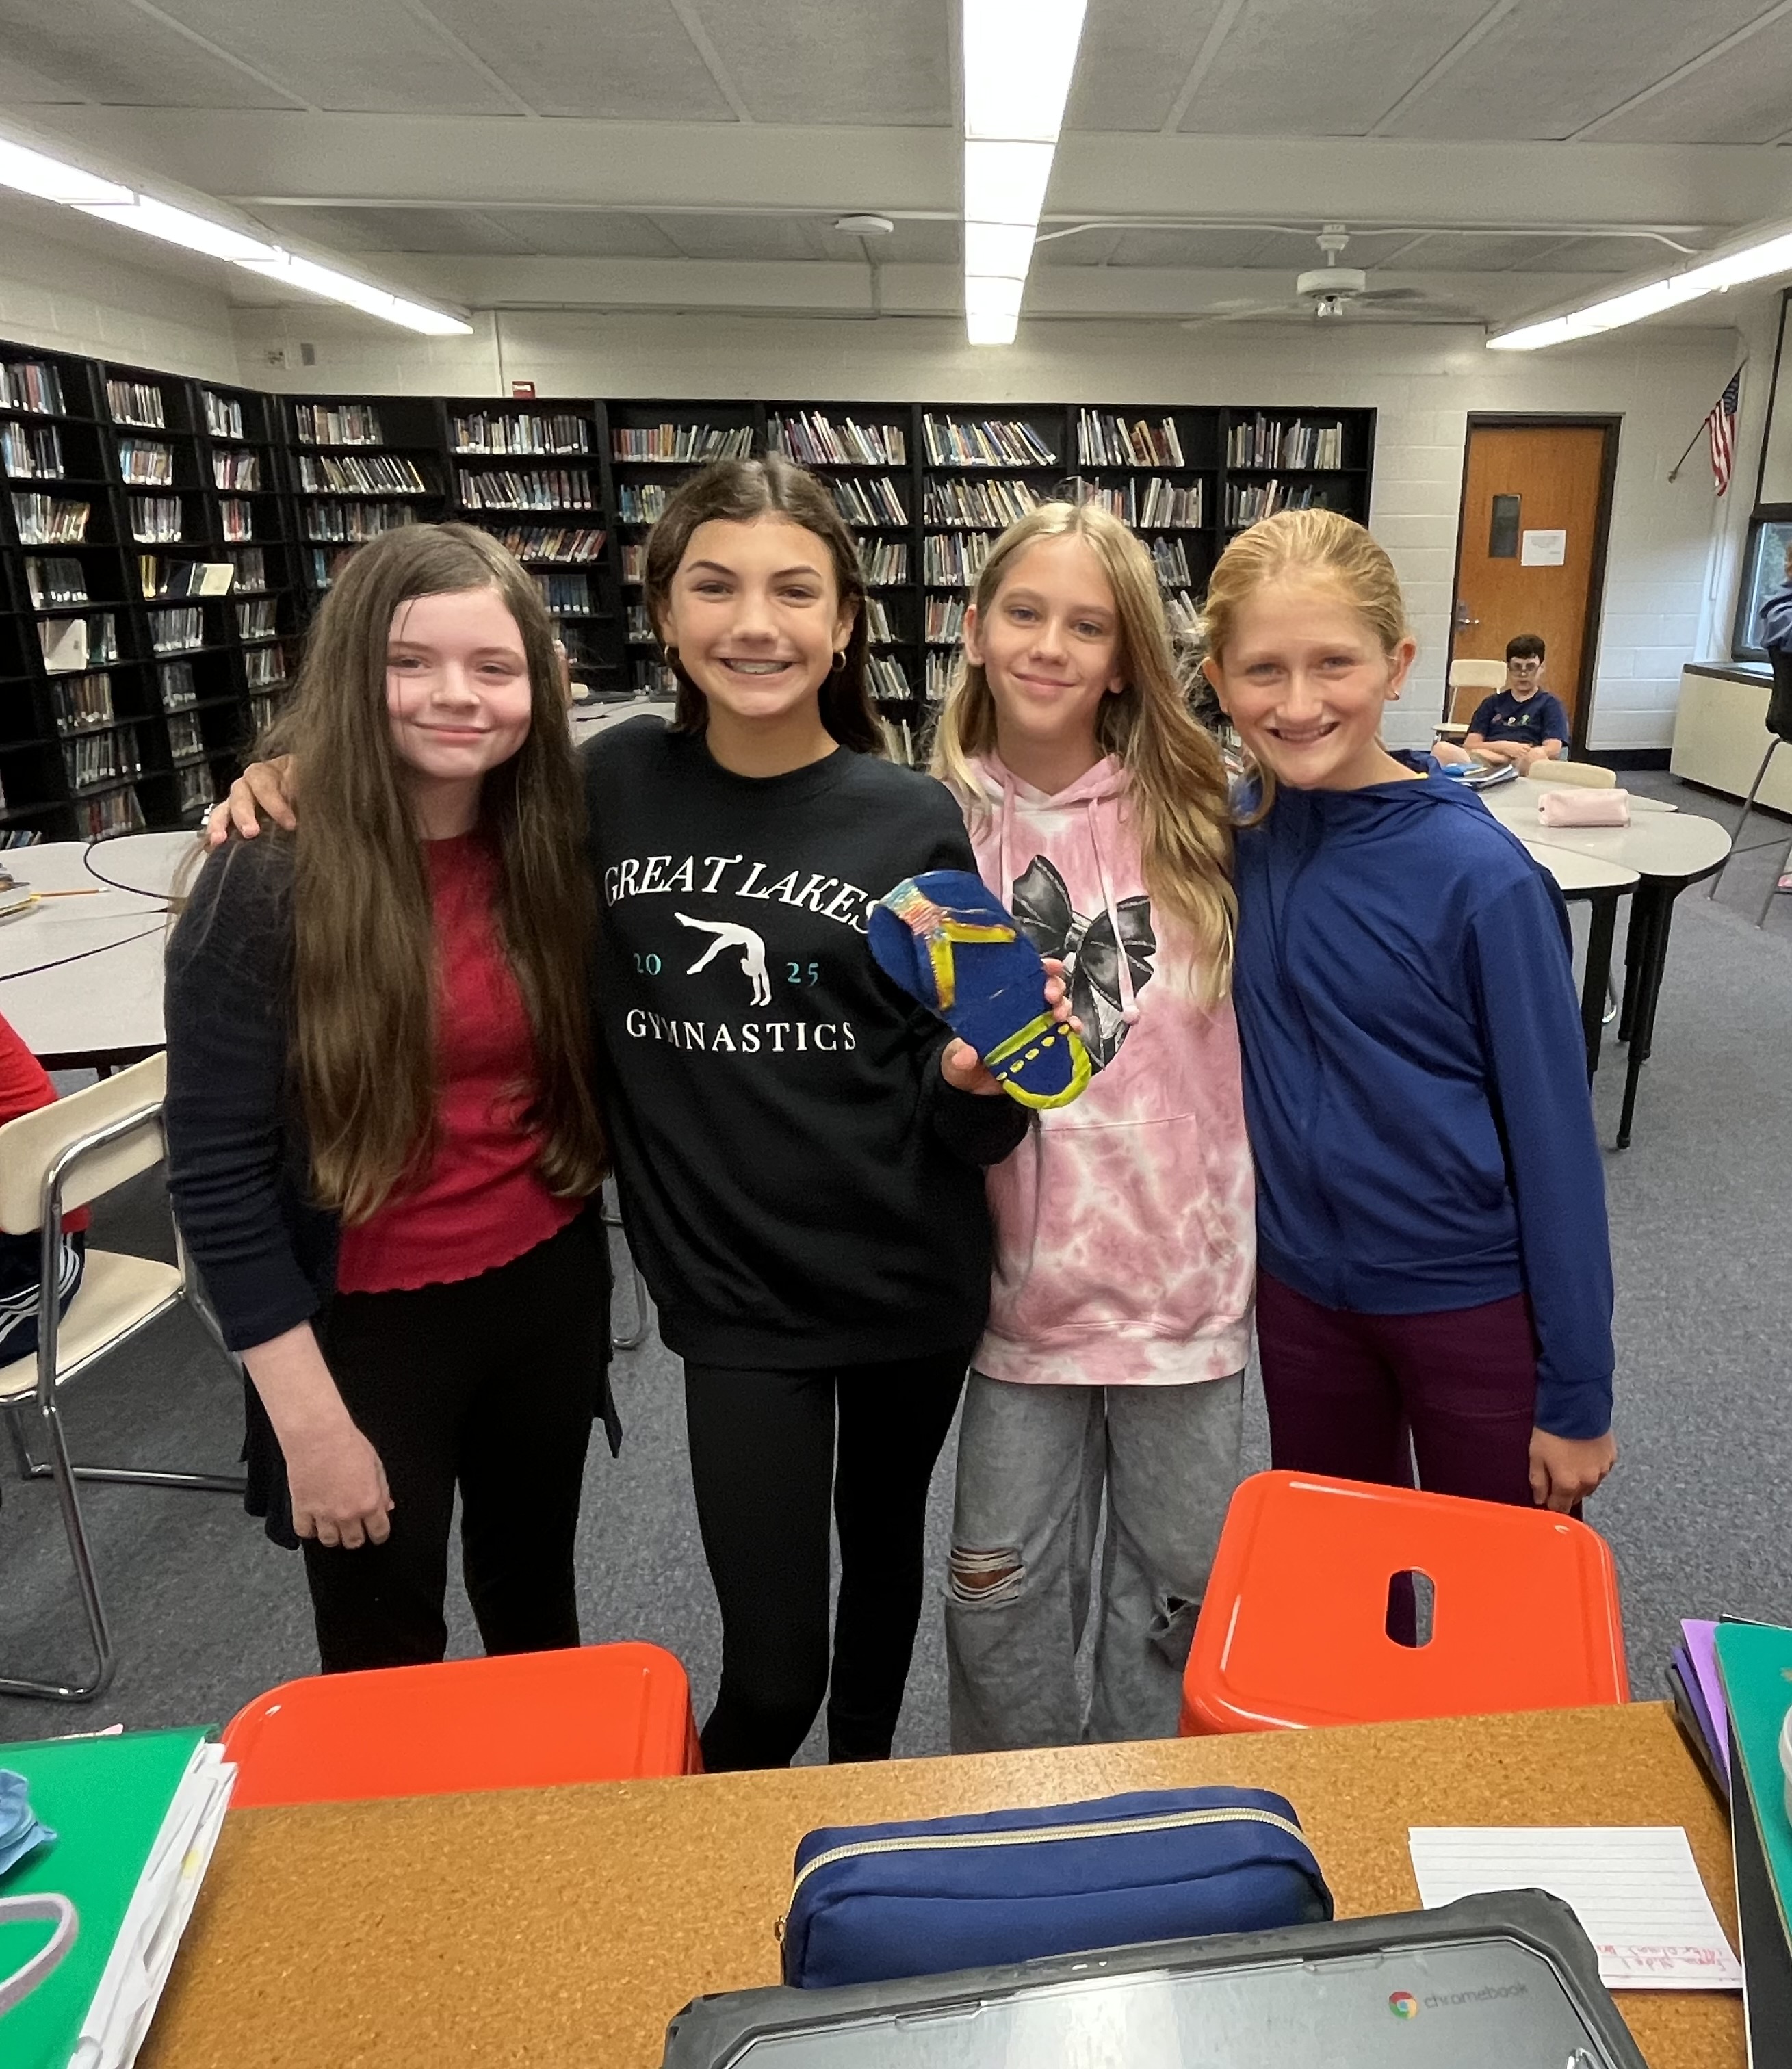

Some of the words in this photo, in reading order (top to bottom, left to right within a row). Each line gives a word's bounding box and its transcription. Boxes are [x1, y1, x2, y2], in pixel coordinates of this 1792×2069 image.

[604, 854, 743, 907] GREAT
[634, 953, 662, 976] 20
[785, 961, 820, 987] 25
[626, 1009, 856, 1052] GYMNASTICS
[1423, 1981, 1528, 2009] chromebook
